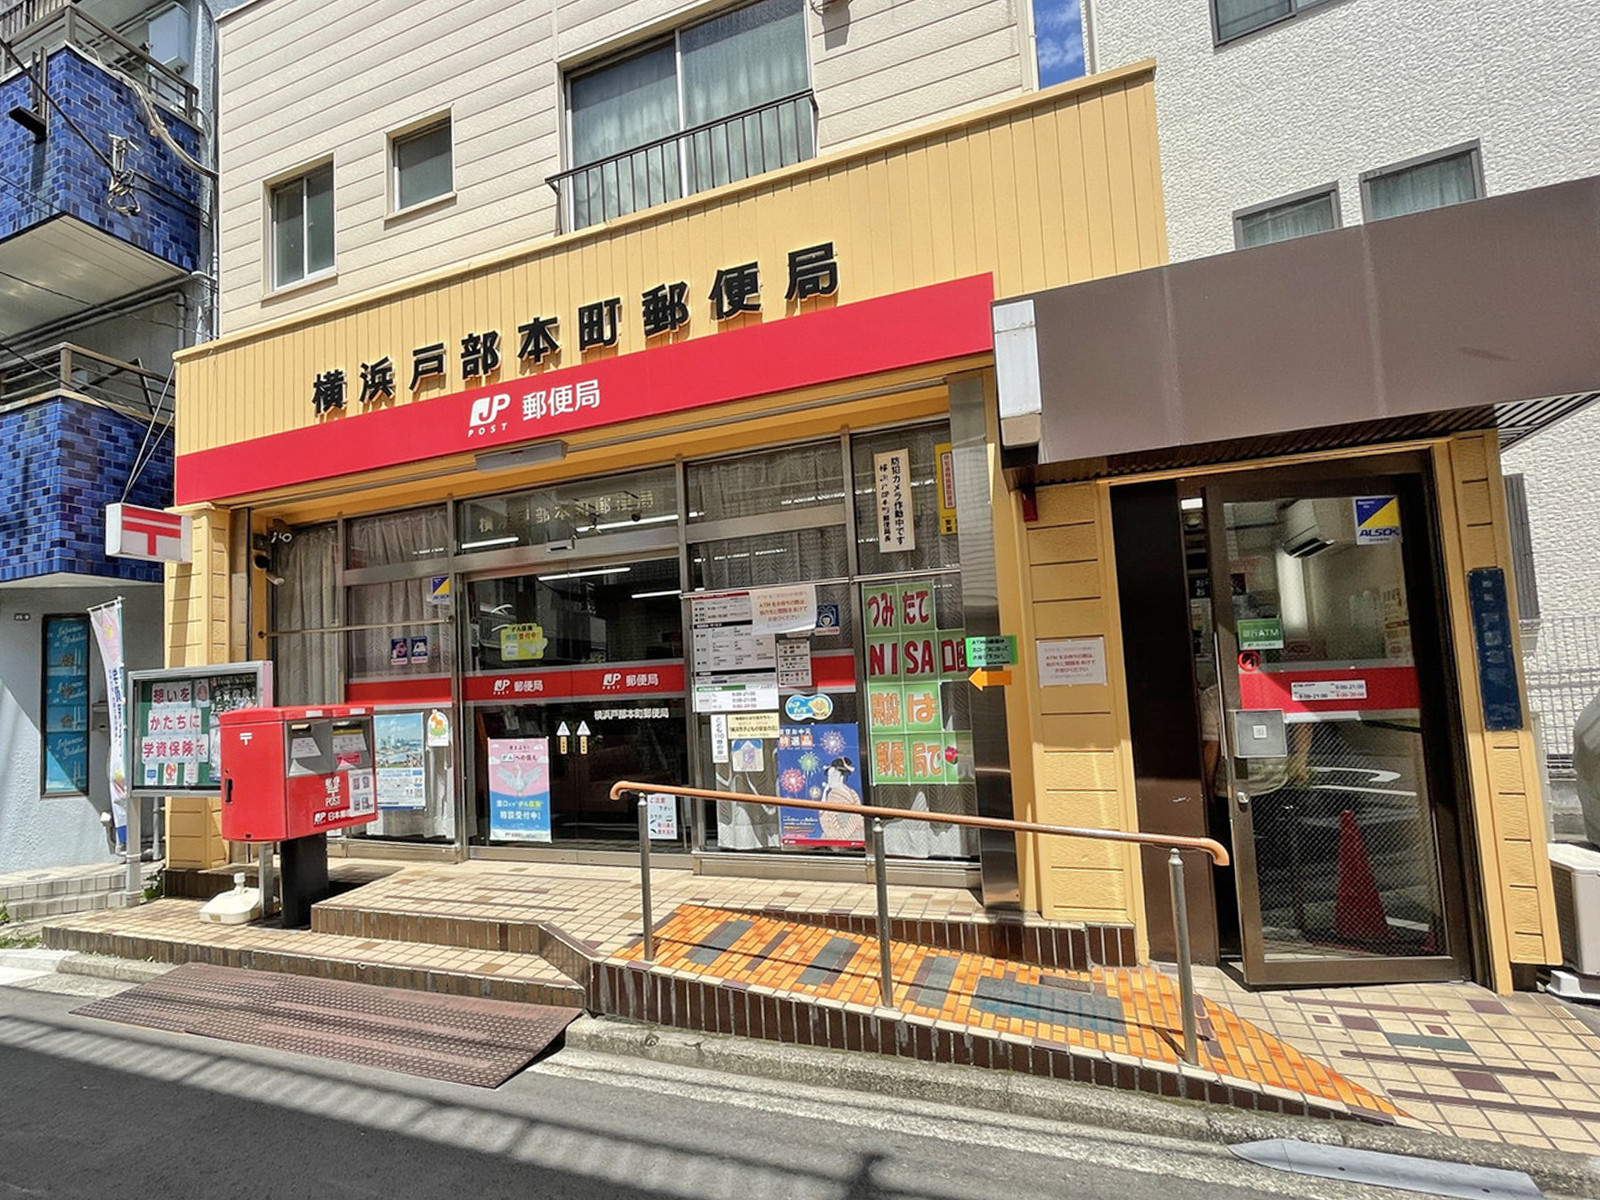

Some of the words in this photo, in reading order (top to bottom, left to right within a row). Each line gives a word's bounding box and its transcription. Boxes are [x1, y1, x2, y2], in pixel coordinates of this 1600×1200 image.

[312, 241, 837, 413] 横浜戸部本町郵便局
[522, 379, 601, 421] 郵便局
[468, 422, 508, 438] POST
[890, 456, 905, 546] 防犯カメラ作動中です
[1359, 527, 1400, 537] ALSOK
[867, 589, 930, 628] つみたて
[513, 679, 543, 692] 郵便局
[625, 673, 659, 687] 郵便局
[153, 687, 191, 705] 想いを
[149, 714, 200, 731] かたちに
[874, 741, 943, 778] 郵便局で
[325, 796, 341, 808] POST
